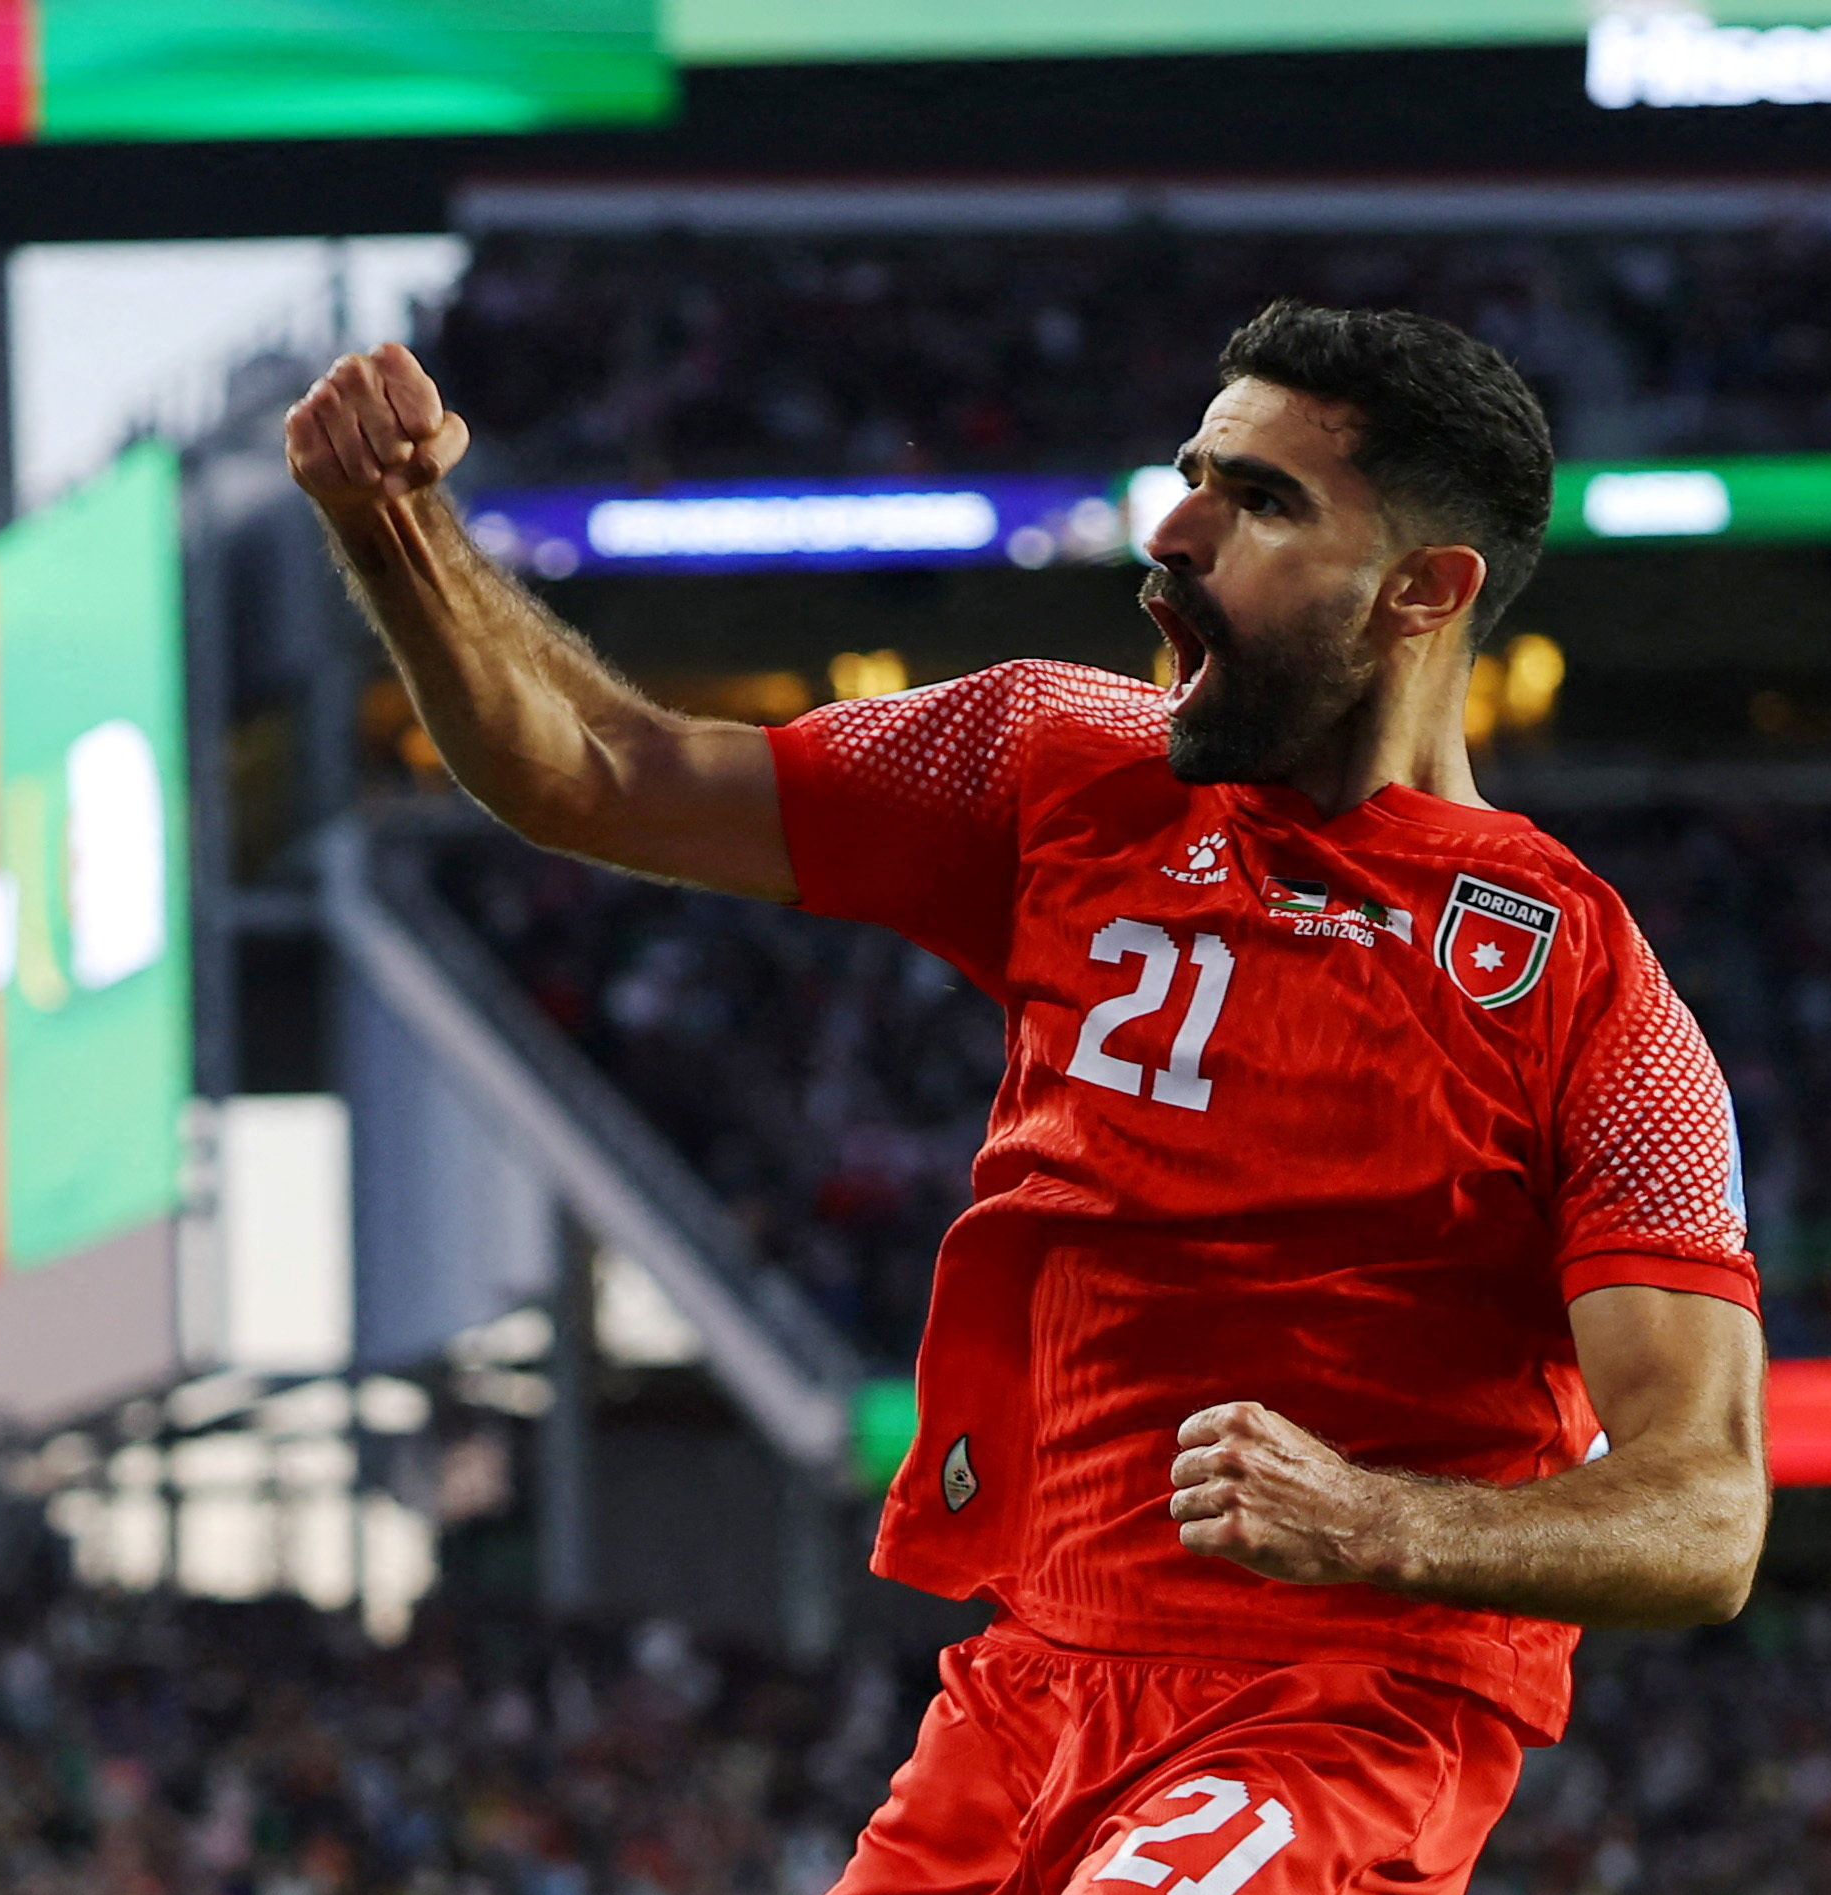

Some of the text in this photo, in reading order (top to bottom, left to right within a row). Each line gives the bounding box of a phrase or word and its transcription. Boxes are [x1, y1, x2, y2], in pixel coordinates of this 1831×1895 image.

[1160, 865, 1230, 884] KELME
[1467, 887, 1545, 927] JORDAN
[1294, 918, 1375, 948] 22/6/2026
[1065, 916, 1236, 1112] 21
